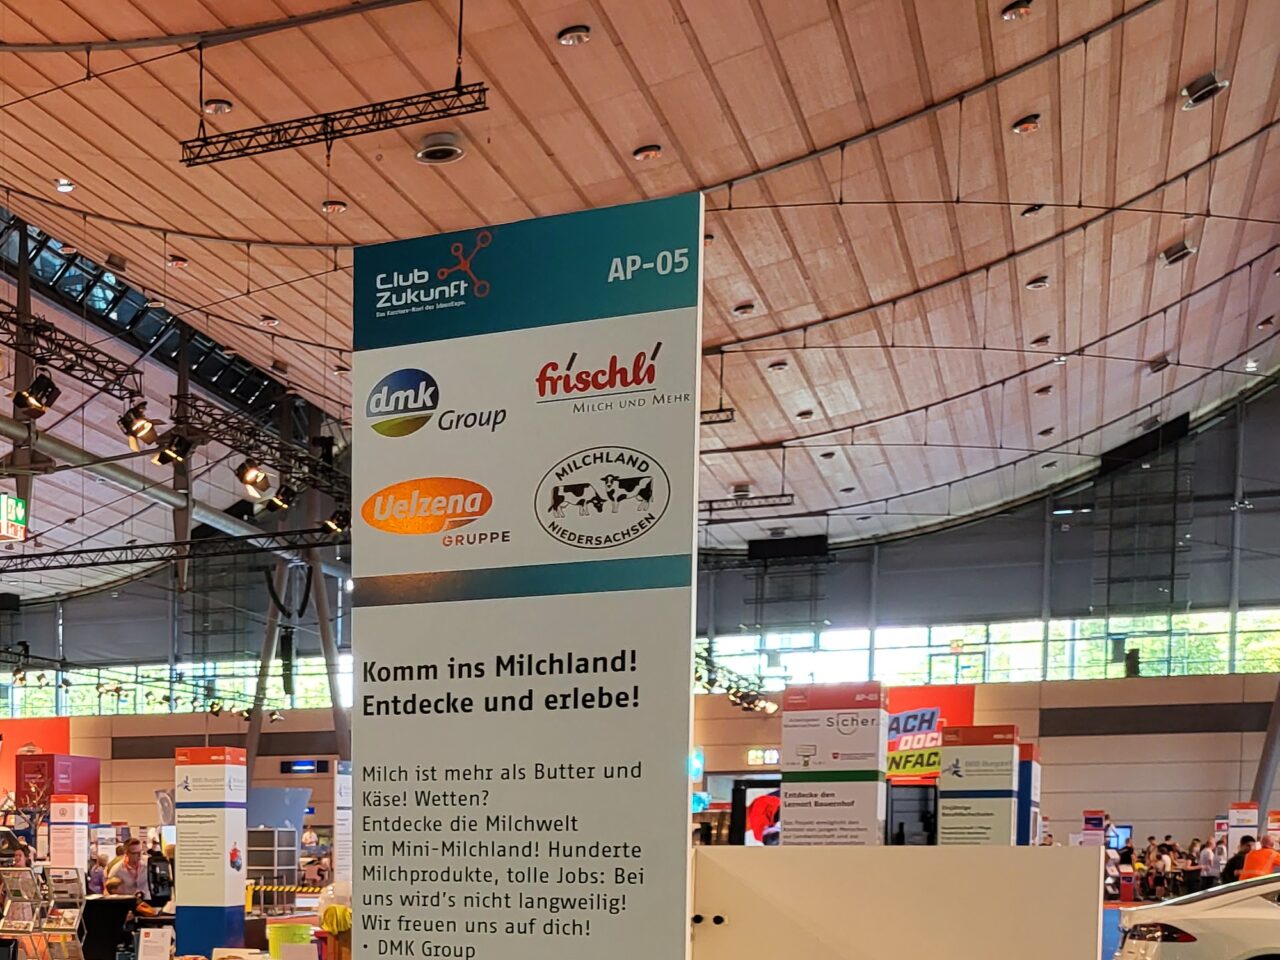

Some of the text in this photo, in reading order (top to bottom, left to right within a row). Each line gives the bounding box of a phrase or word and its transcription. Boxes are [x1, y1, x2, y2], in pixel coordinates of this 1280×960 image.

[608, 248, 689, 282] AP-05
[376, 269, 429, 289] Club
[369, 381, 437, 414] dmk
[573, 392, 690, 414] MILCH UND MEHR
[438, 408, 507, 432] Group
[555, 451, 650, 482] MILCHLAND
[373, 490, 483, 522] Uelzena
[441, 530, 511, 547] GRUPPE
[547, 513, 656, 545] NIEDERSACHSEN
[363, 650, 637, 683] Komm ins Milchland!
[363, 686, 640, 716] Entdecke und erlebe!
[899, 732, 942, 750] DOC
[363, 761, 642, 782] Milch ist mehr als Butter und
[887, 752, 941, 770] NFAC
[363, 790, 489, 807] Käse! Wetten?
[363, 815, 578, 831] Entdecke die Milchwelt
[362, 841, 642, 859] im Mini-Milchland! Hunderte
[363, 866, 644, 886] Milchprodukte, tolle Jobs: Bei
[363, 892, 626, 914] uns wird's nicht langweilig!
[362, 915, 591, 936] Wir freuen uns auf dich!
[379, 940, 476, 960] DMK Group
